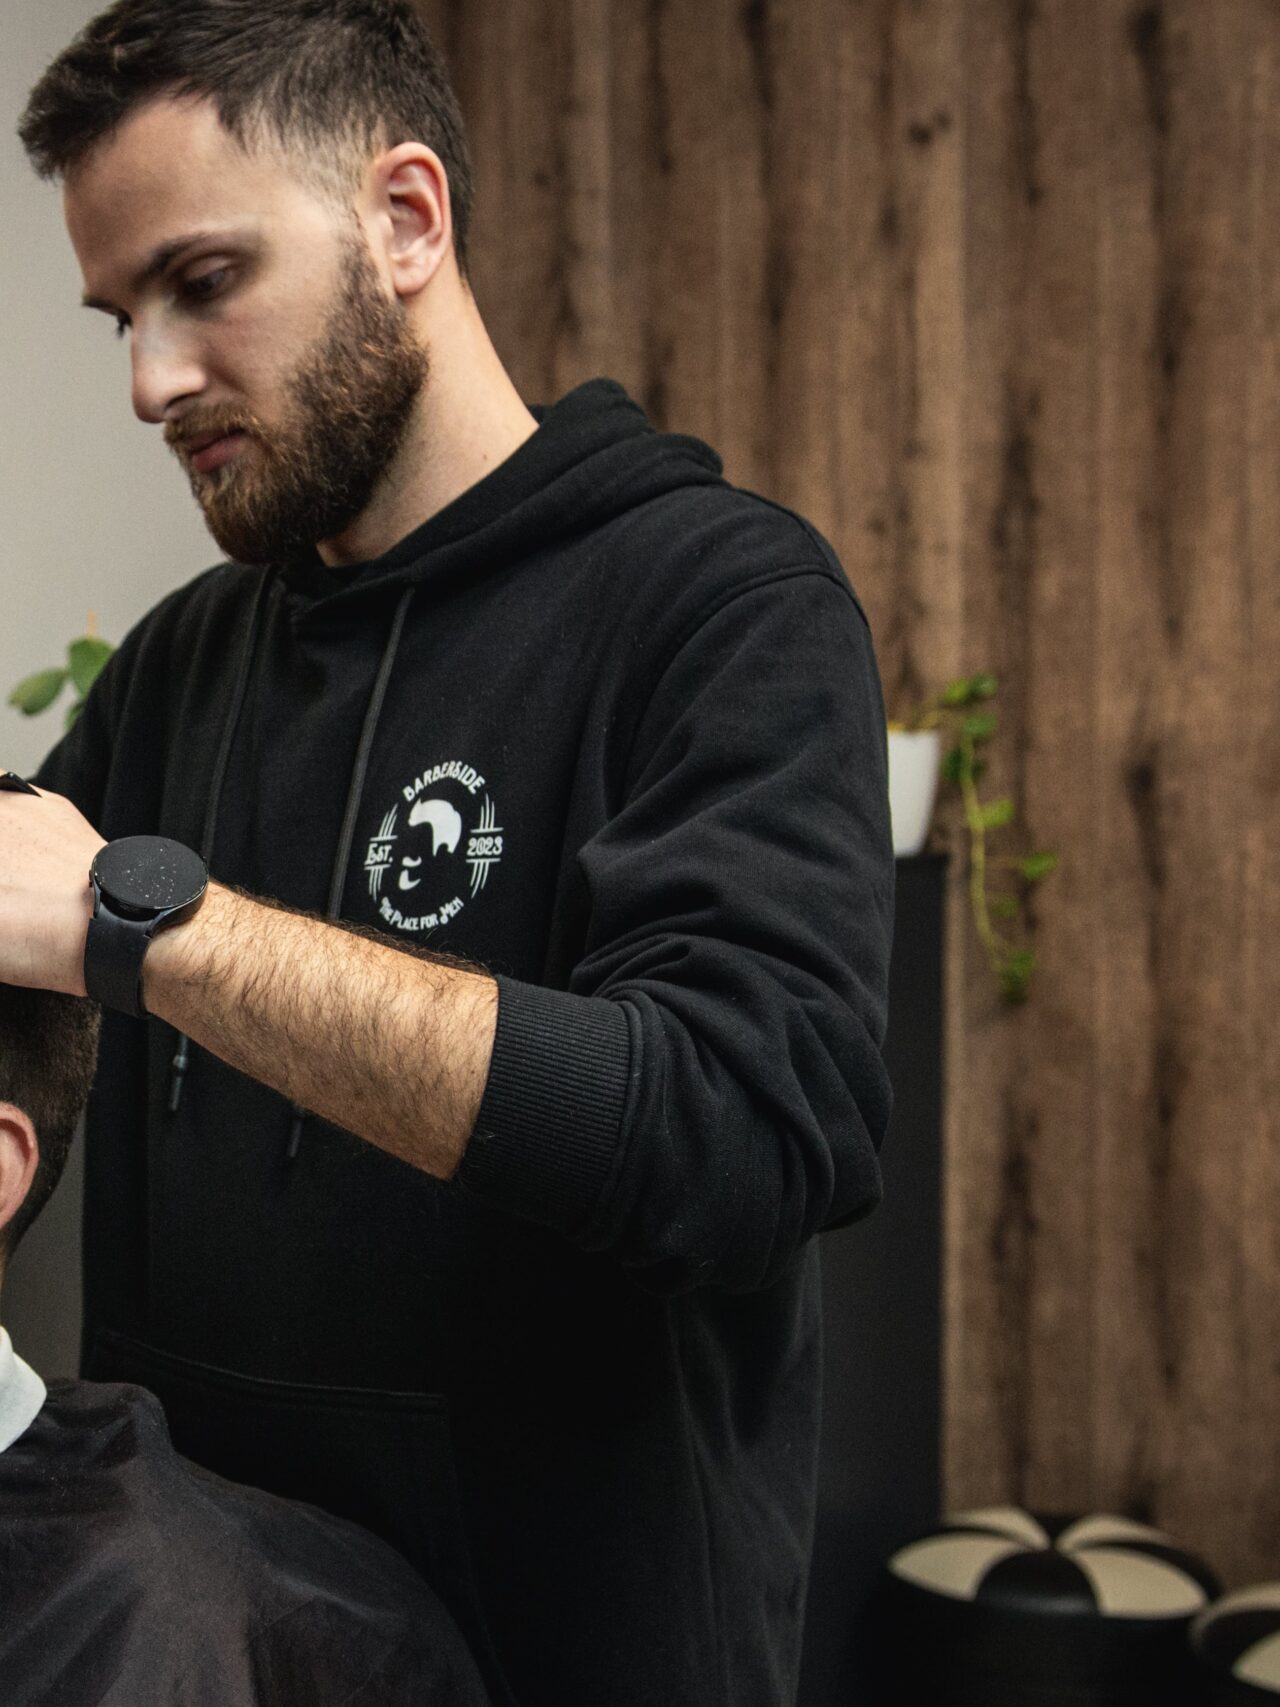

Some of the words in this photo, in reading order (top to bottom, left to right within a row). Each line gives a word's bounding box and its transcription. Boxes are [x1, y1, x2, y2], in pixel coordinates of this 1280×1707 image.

[403, 760, 486, 802] BARBERSIDE
[466, 836, 503, 856] 2023
[389, 910, 420, 931] PLACE
[420, 913, 439, 930] FOR
